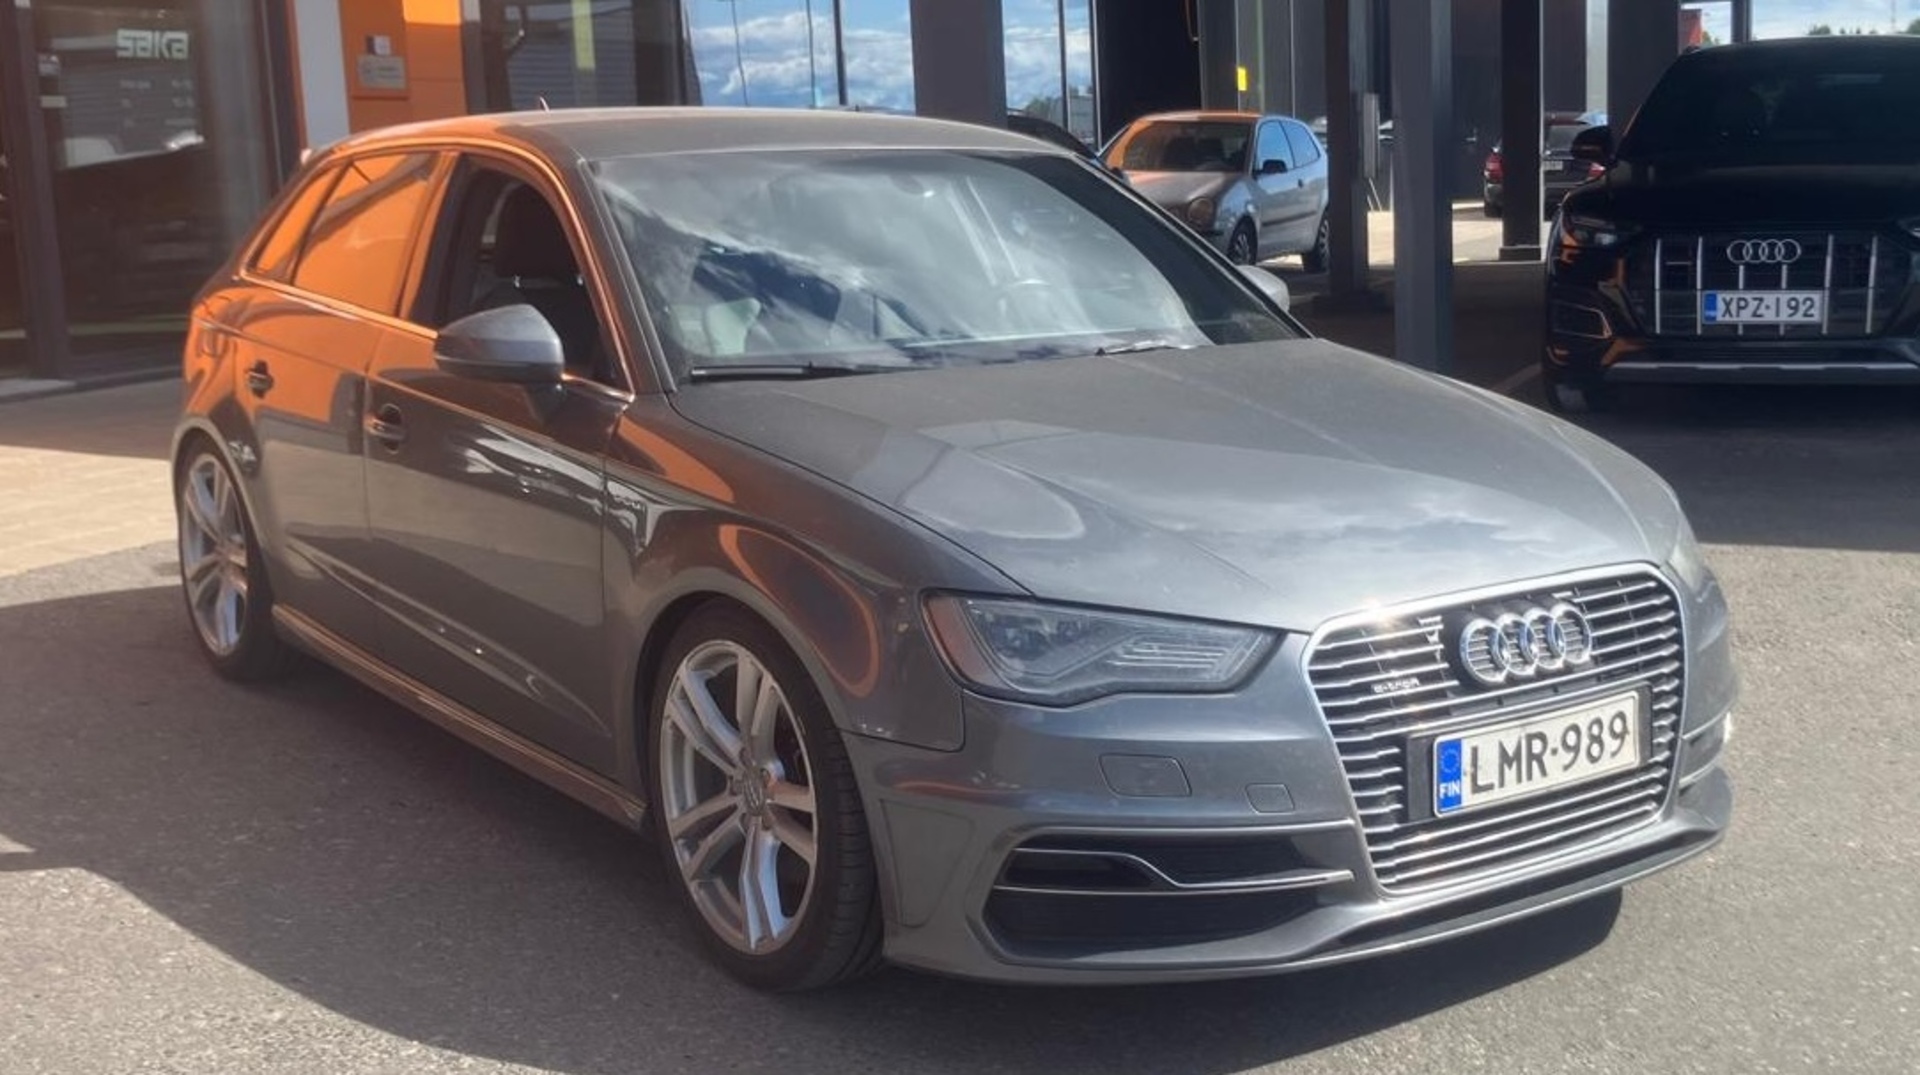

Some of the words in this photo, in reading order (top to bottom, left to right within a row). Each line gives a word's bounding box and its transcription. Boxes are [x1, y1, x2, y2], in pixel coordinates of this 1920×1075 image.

[1721, 296, 1815, 318] XPZ-192
[1470, 711, 1630, 794] LMR-989
[1439, 780, 1461, 799] FIN
